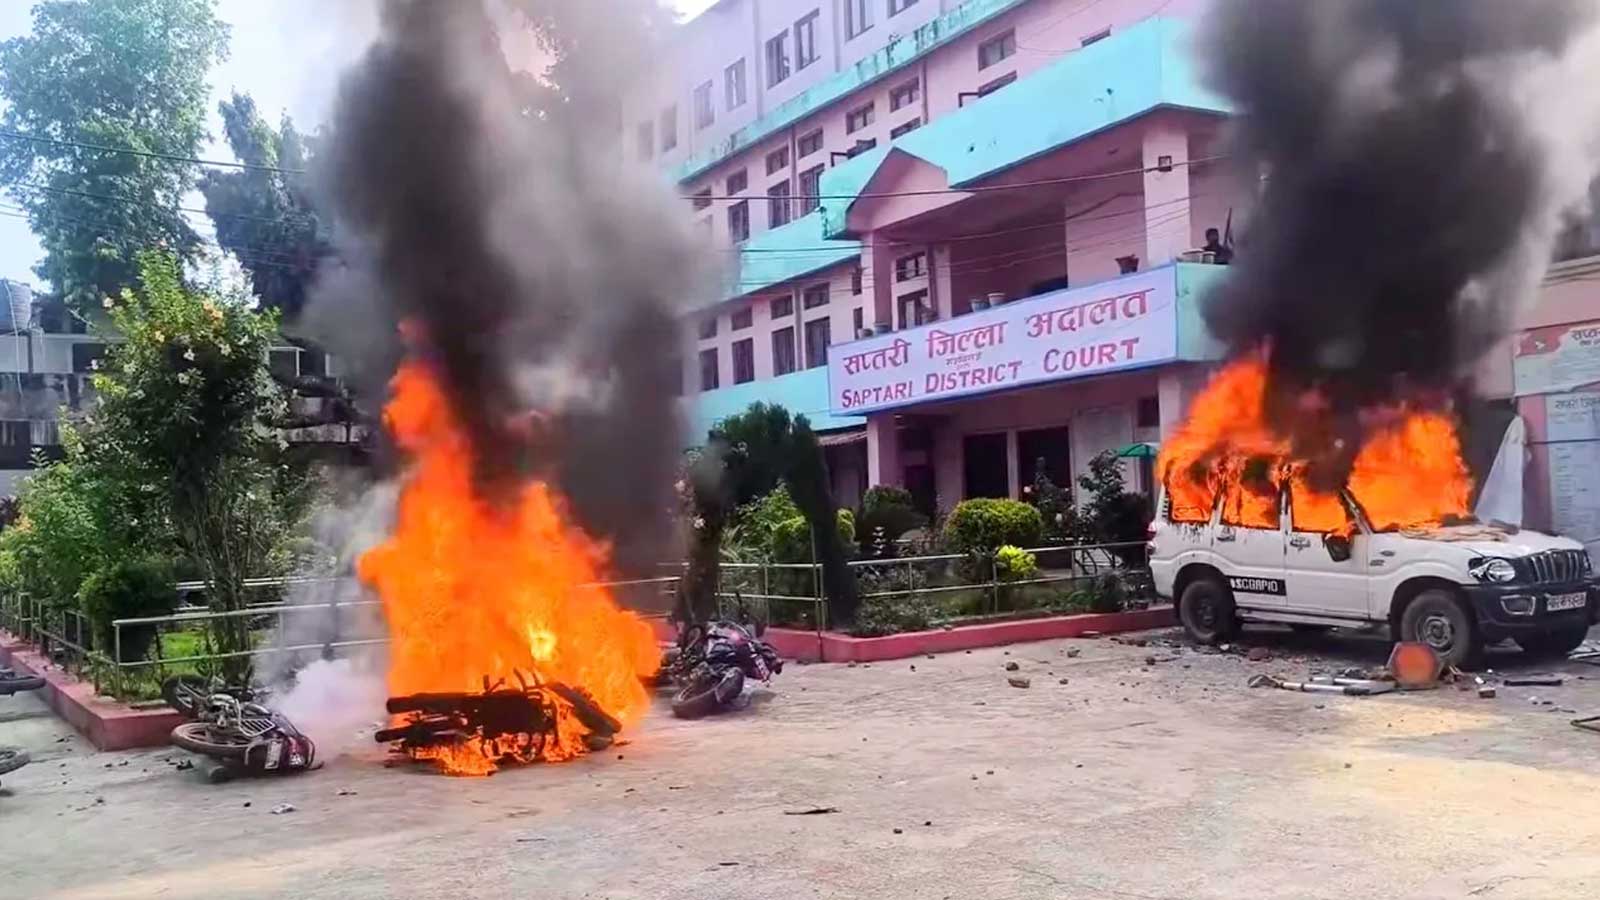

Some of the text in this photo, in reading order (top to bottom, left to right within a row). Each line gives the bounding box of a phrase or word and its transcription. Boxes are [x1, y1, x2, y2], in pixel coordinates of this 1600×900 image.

[842, 338, 912, 375] सप्तरी
[926, 321, 1008, 359] जिल्ला
[1024, 288, 1156, 338] अदालत
[842, 338, 1140, 408] SAPTARI DISTRICT COURT
[1235, 577, 1278, 592] SCORPIO
